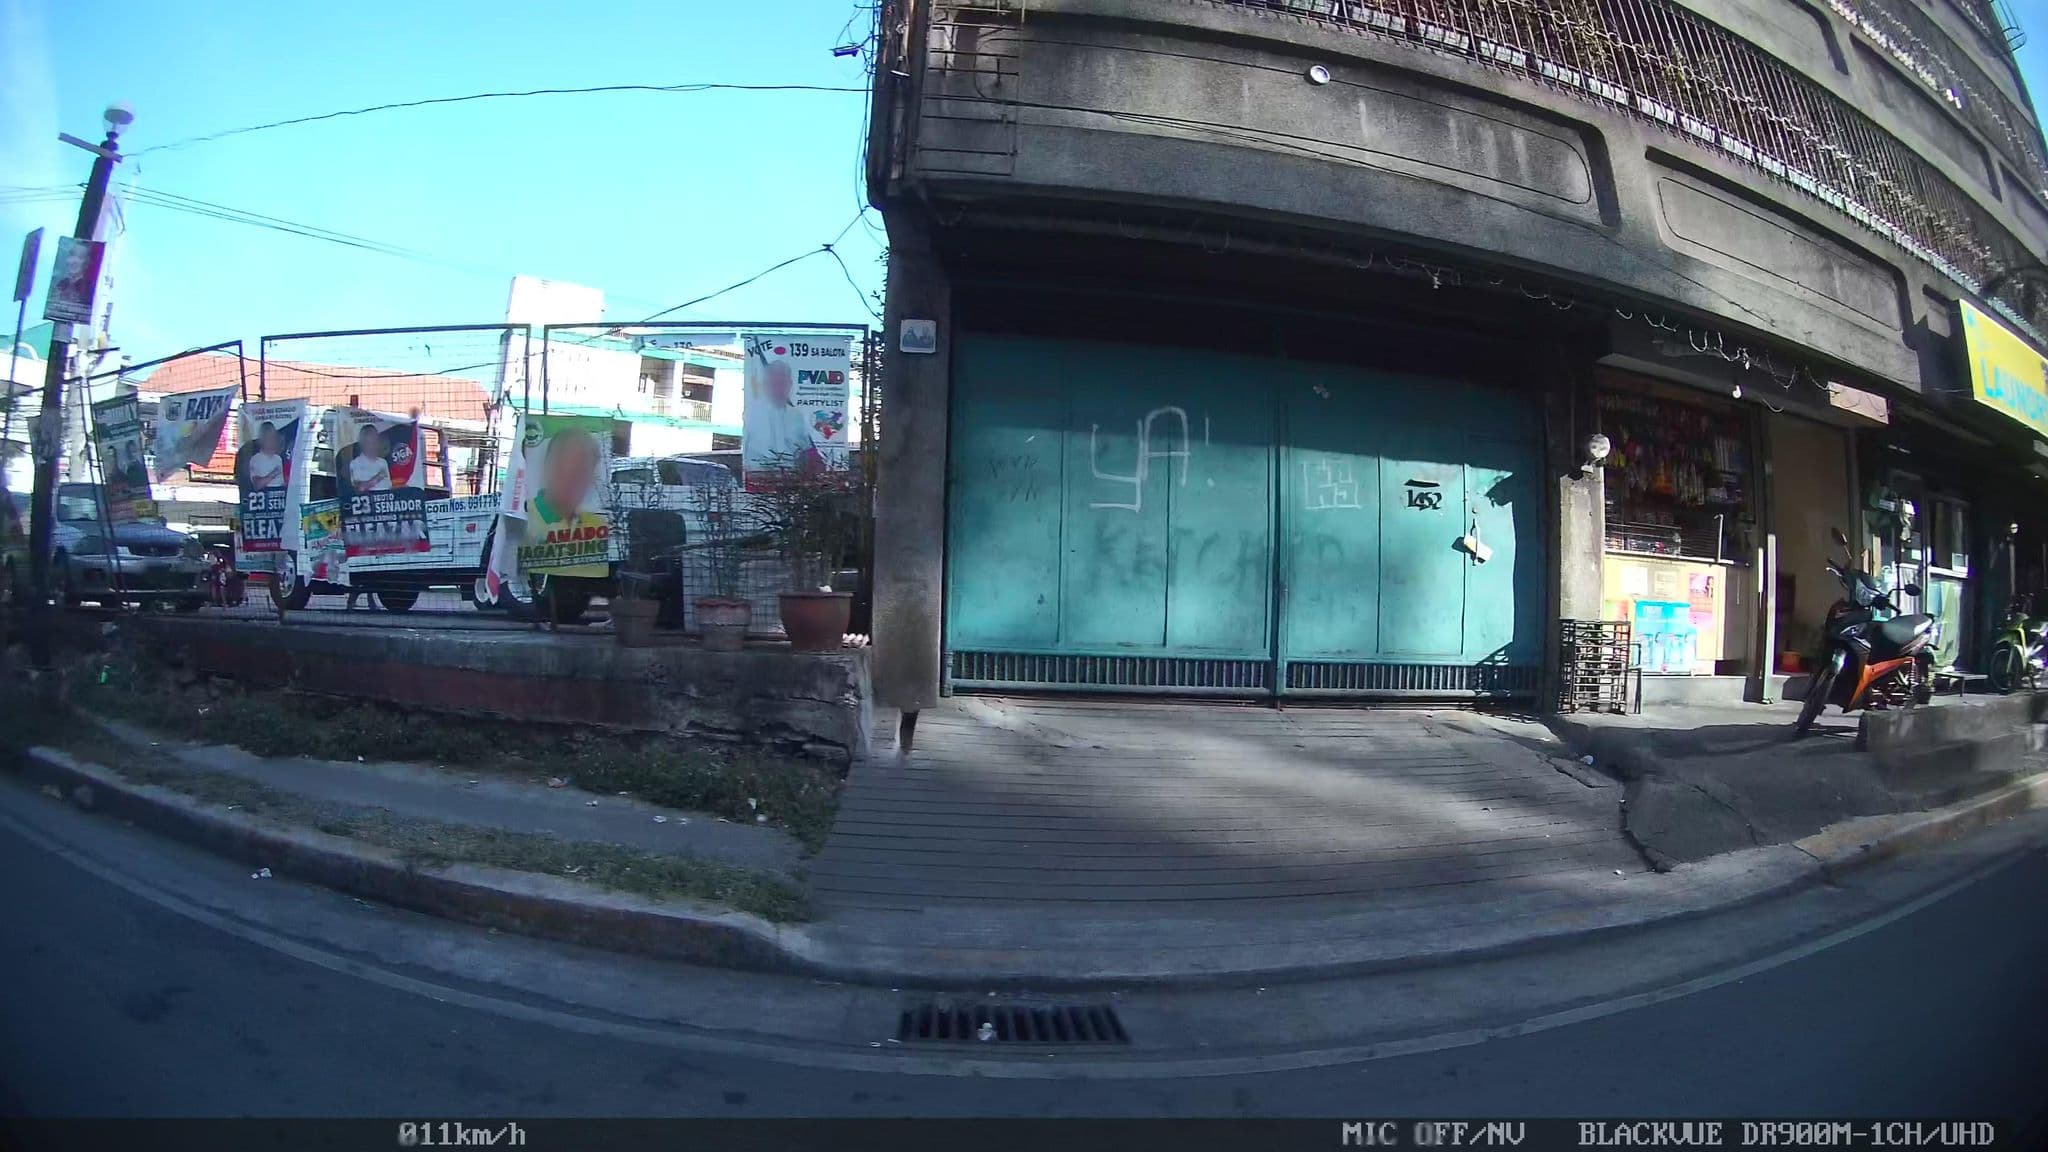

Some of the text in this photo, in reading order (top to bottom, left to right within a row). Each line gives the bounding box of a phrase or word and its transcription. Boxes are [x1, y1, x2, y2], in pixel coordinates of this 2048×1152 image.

[748, 340, 773, 358] VOTE
[790, 343, 845, 357] 139 SA BALOTA
[249, 492, 265, 511] 23
[352, 495, 371, 515] 23
[375, 500, 422, 513] SENADOR
[1406, 489, 1442, 511] 1452
[546, 525, 609, 544] AMADO
